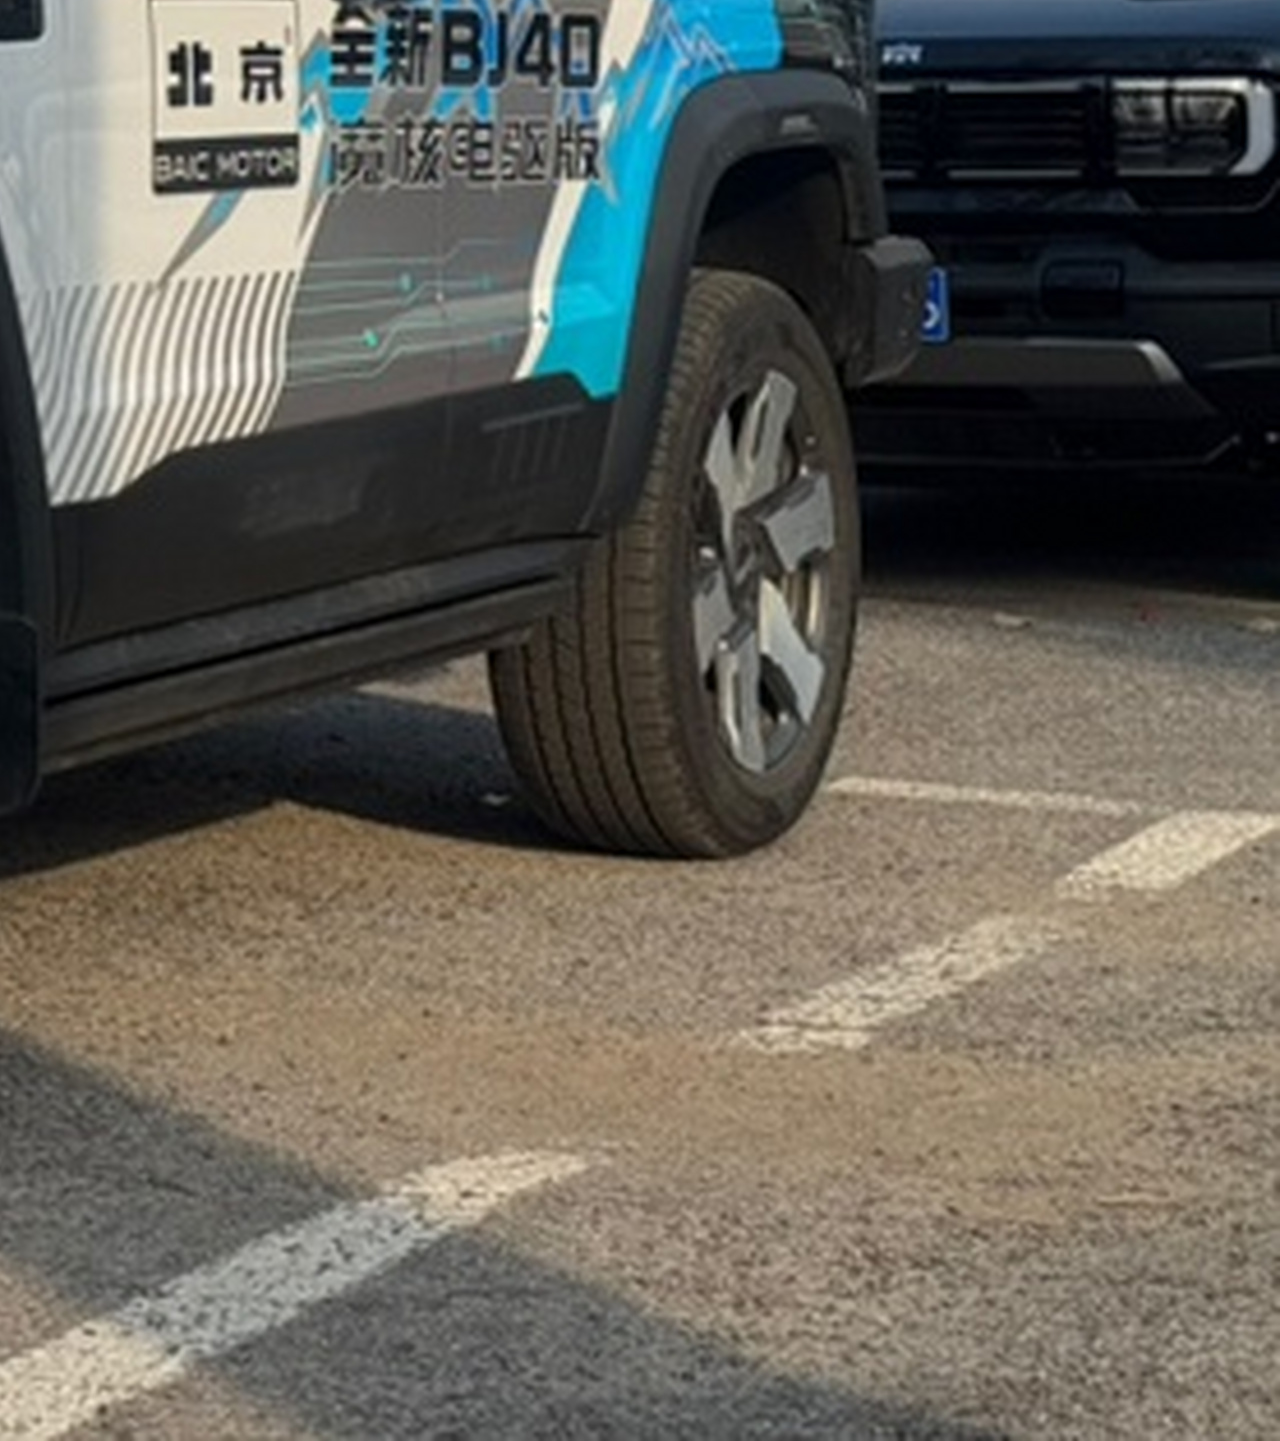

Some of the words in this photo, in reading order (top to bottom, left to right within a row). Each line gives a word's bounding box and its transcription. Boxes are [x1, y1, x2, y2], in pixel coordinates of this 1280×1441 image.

[166, 40, 285, 108] 北京
[329, 3, 600, 89] 全新BJ40
[155, 150, 210, 184] BAIC
[215, 145, 296, 178] MOTOR
